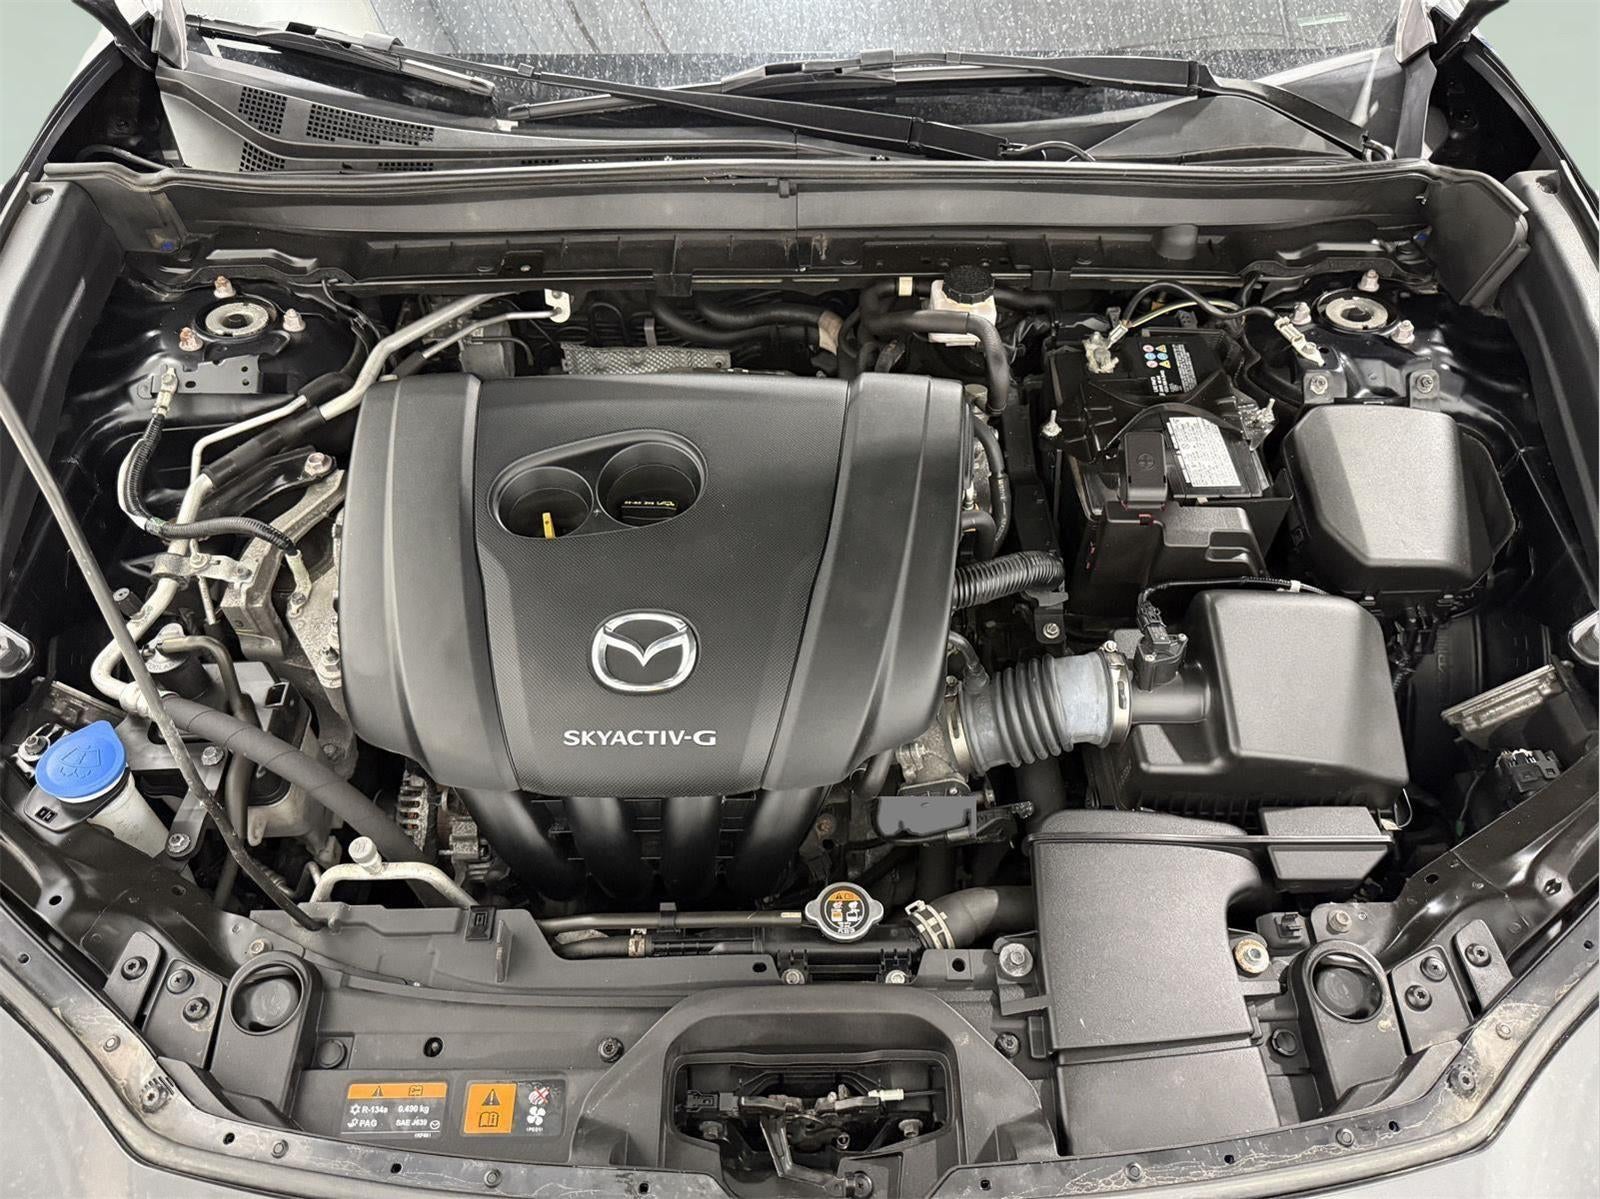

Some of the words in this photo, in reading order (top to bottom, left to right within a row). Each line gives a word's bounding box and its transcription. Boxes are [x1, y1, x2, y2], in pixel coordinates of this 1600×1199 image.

[563, 729, 717, 746] SKYACTIV-G
[361, 1105, 388, 1114] R-134a
[398, 1104, 419, 1113] 0.490
[419, 1104, 430, 1114] kg
[359, 1119, 378, 1128] PAG
[395, 1118, 411, 1127] SAE
